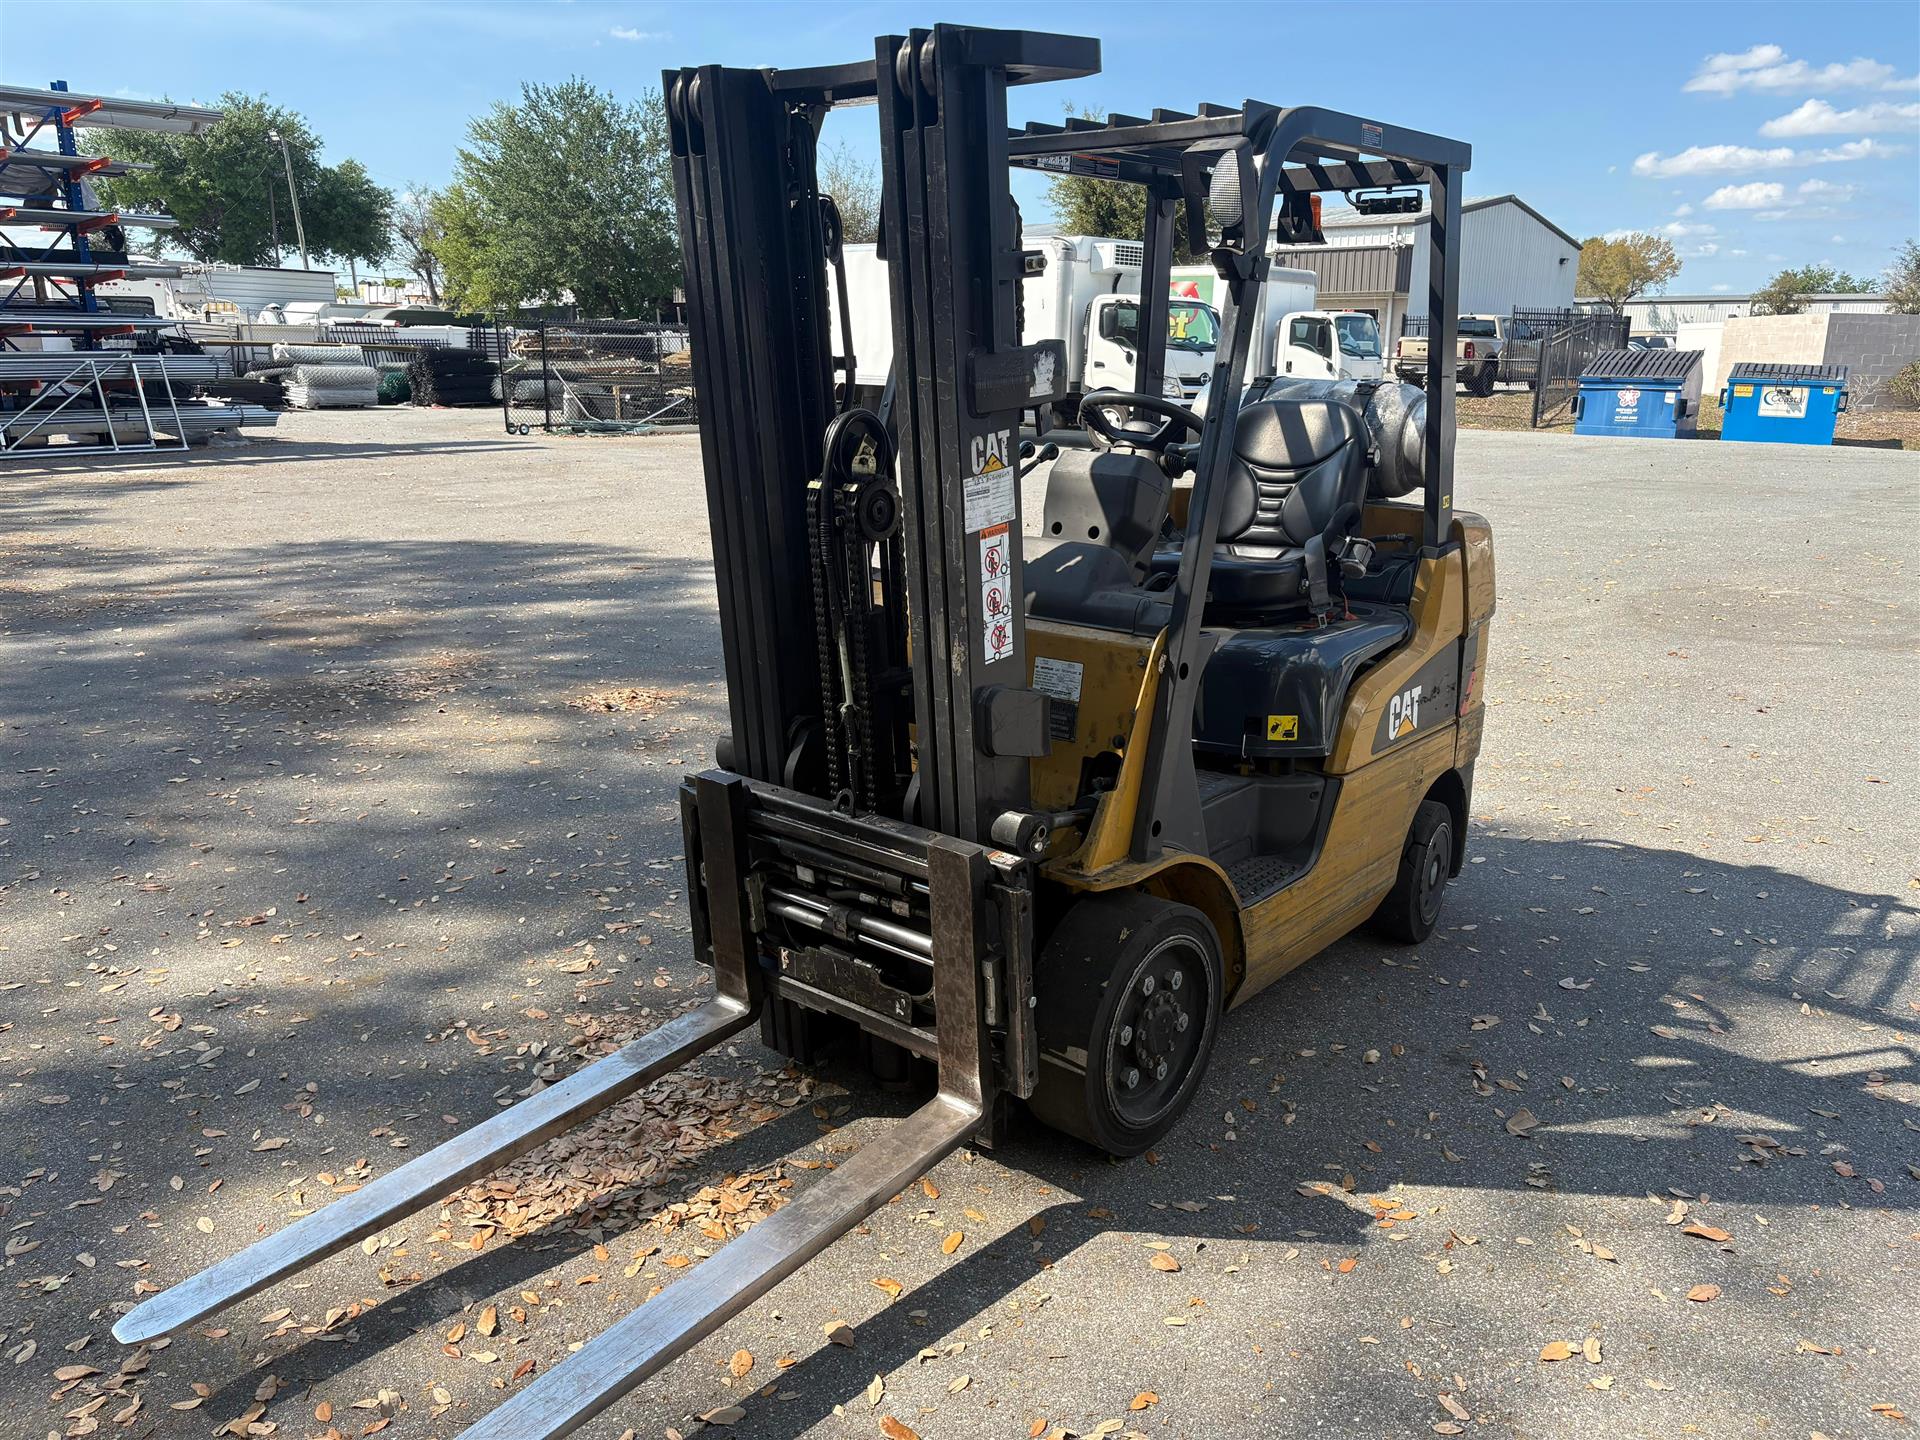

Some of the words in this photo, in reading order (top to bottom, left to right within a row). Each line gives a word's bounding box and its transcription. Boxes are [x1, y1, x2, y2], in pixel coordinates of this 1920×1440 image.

[971, 429, 1010, 475] CAT
[988, 527, 1009, 538] WARNING
[1389, 685, 1422, 741] CAT
